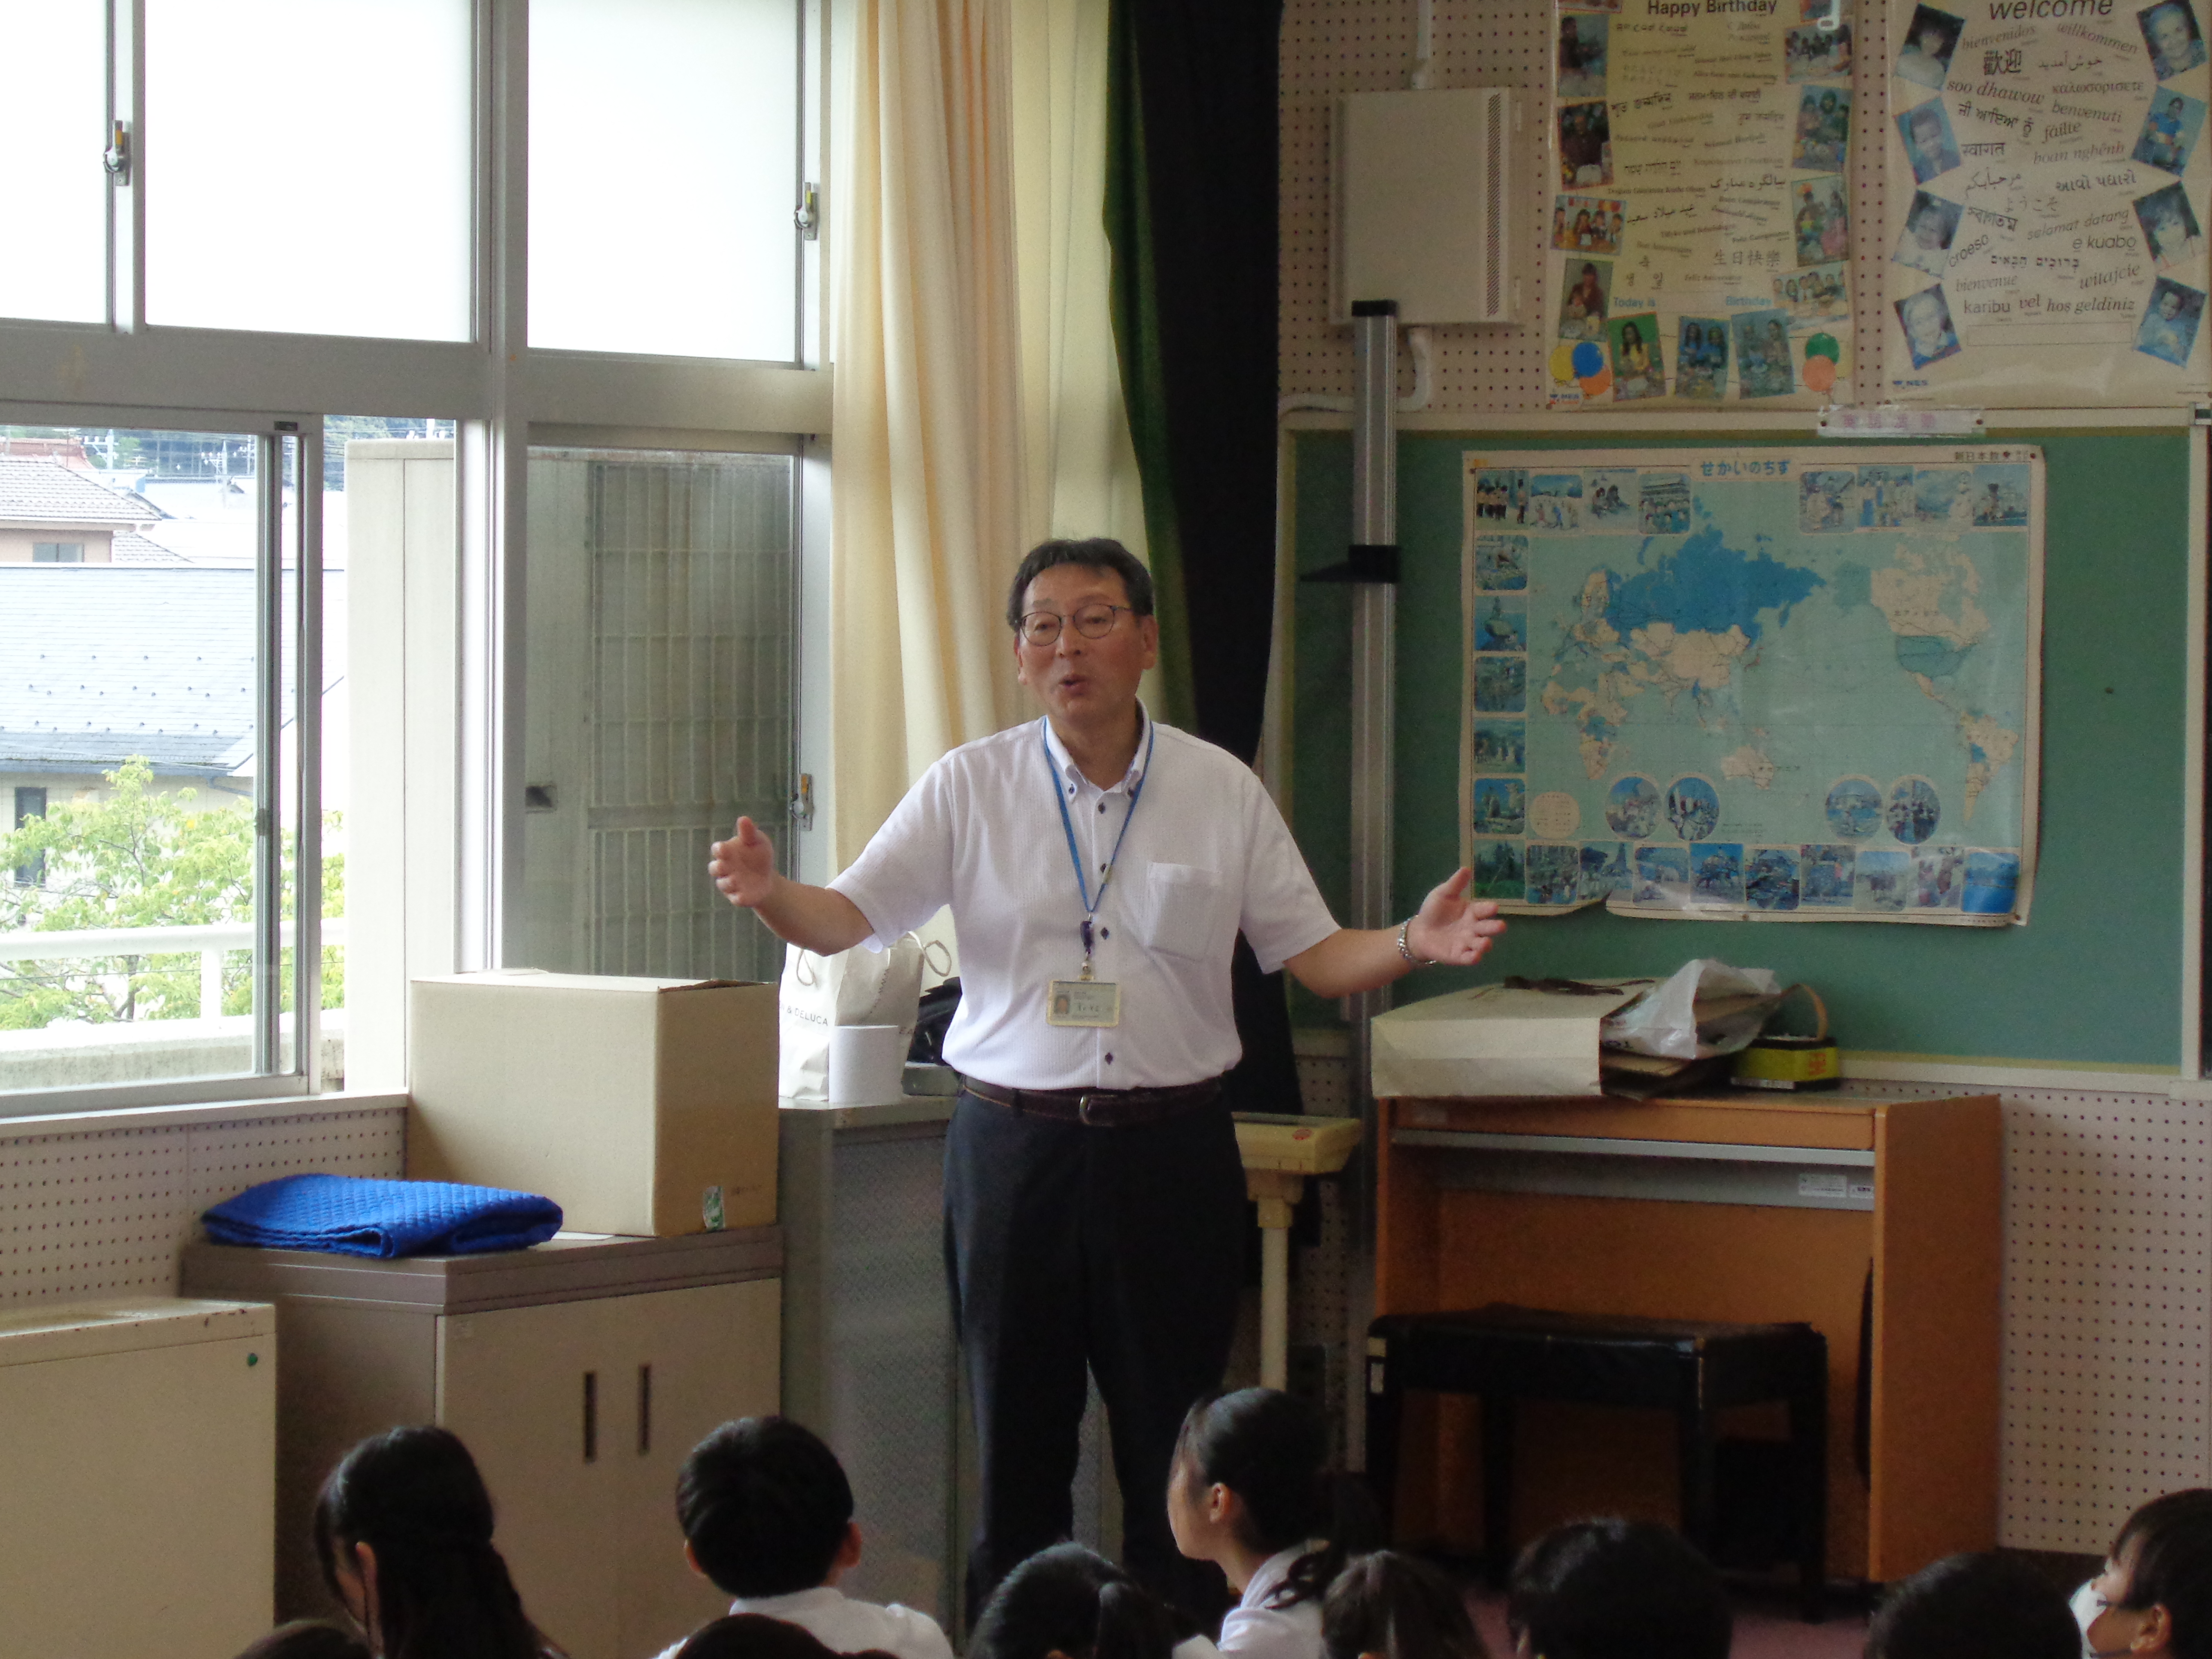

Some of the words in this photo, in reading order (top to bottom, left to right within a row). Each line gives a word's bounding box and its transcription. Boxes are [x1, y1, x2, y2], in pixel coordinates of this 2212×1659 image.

[1648, 0, 1700, 18] Happy
[1707, 0, 1777, 15] Birthday
[1990, 0, 2112, 19] welcome
[2057, 24, 2138, 54] willkommen
[1984, 49, 2021, 75] 歡迎
[1947, 81, 1972, 93] soo
[2052, 100, 2122, 123] benvenuti
[2005, 196, 2057, 213] ようこそ
[2027, 220, 2079, 240] selamat
[2083, 210, 2128, 228] datang
[1714, 249, 1781, 267] 生日快樂
[1949, 234, 1988, 267] croeso
[1614, 296, 1644, 308] Today
[1964, 299, 2011, 314] karibu
[2074, 297, 2135, 314] geldiniz
[1700, 459, 1791, 476] せかいのちず
[795, 1008, 828, 1026] DELUCA
